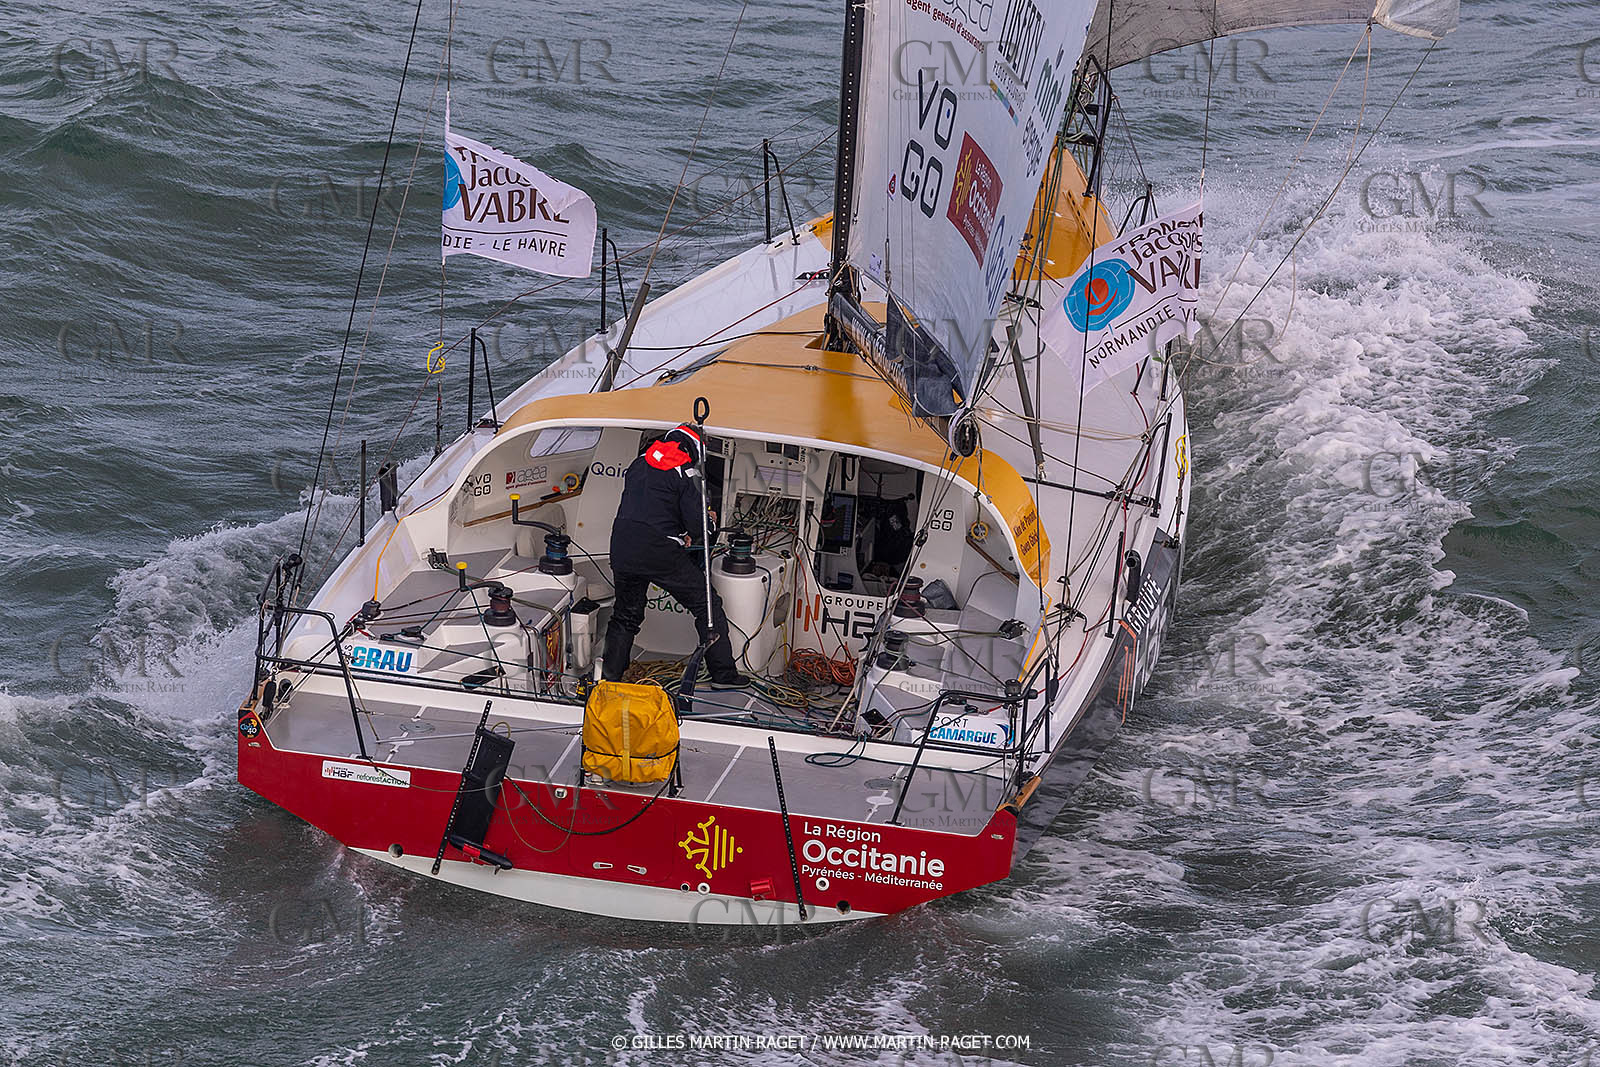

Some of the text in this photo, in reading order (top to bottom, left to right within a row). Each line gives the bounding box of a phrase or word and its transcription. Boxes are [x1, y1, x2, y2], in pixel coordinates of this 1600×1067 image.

[918, 69, 957, 150] VO
[901, 139, 943, 218] GO
[492, 238, 512, 251] LE
[517, 238, 567, 257] HAVRE
[1088, 304, 1176, 369] NORMANDIE
[824, 595, 884, 611] GROUPE
[351, 645, 413, 673] GRAU
[929, 726, 998, 745] CAMARGUE
[803, 821, 882, 843] La Région
[802, 838, 945, 878] Occitanie
[801, 864, 855, 880] Pyrénées
[864, 872, 944, 891] Méditerranée
